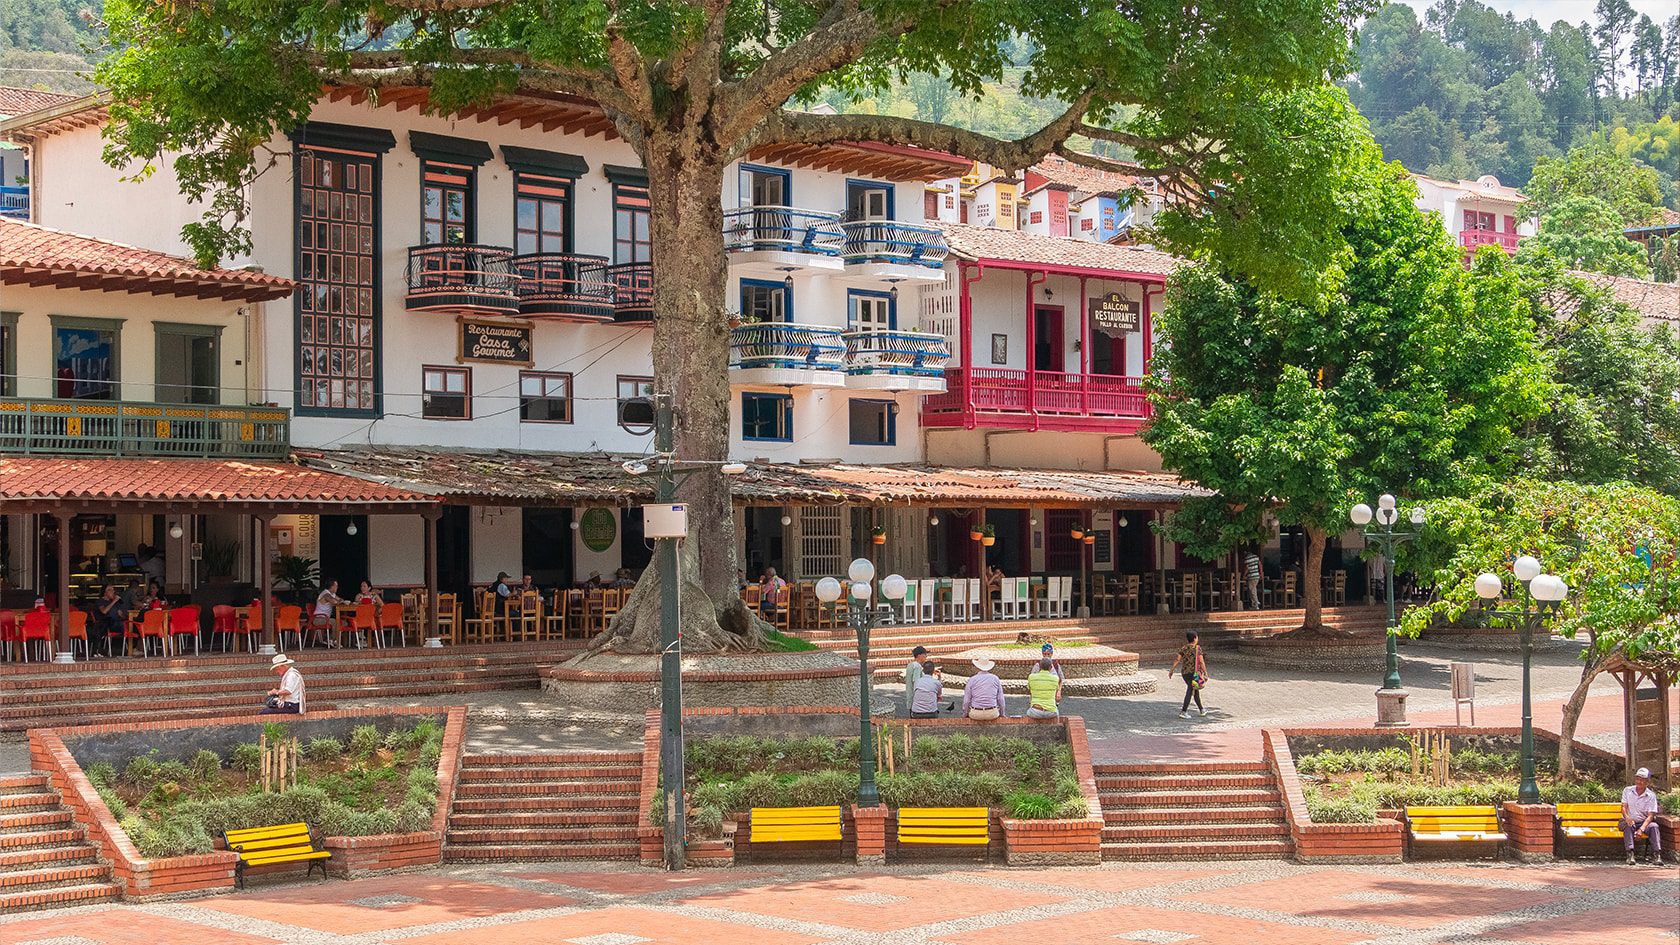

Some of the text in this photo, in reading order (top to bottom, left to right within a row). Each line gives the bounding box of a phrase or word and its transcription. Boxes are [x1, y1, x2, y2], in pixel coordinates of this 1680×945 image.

[1102, 302, 1129, 311] BALCON
[1095, 310, 1136, 323] RESTAURANTE
[468, 324, 522, 337] Restaurante
[479, 334, 510, 348] Casa
[472, 344, 516, 357] Gourmet
[299, 514, 310, 537] GOUR
